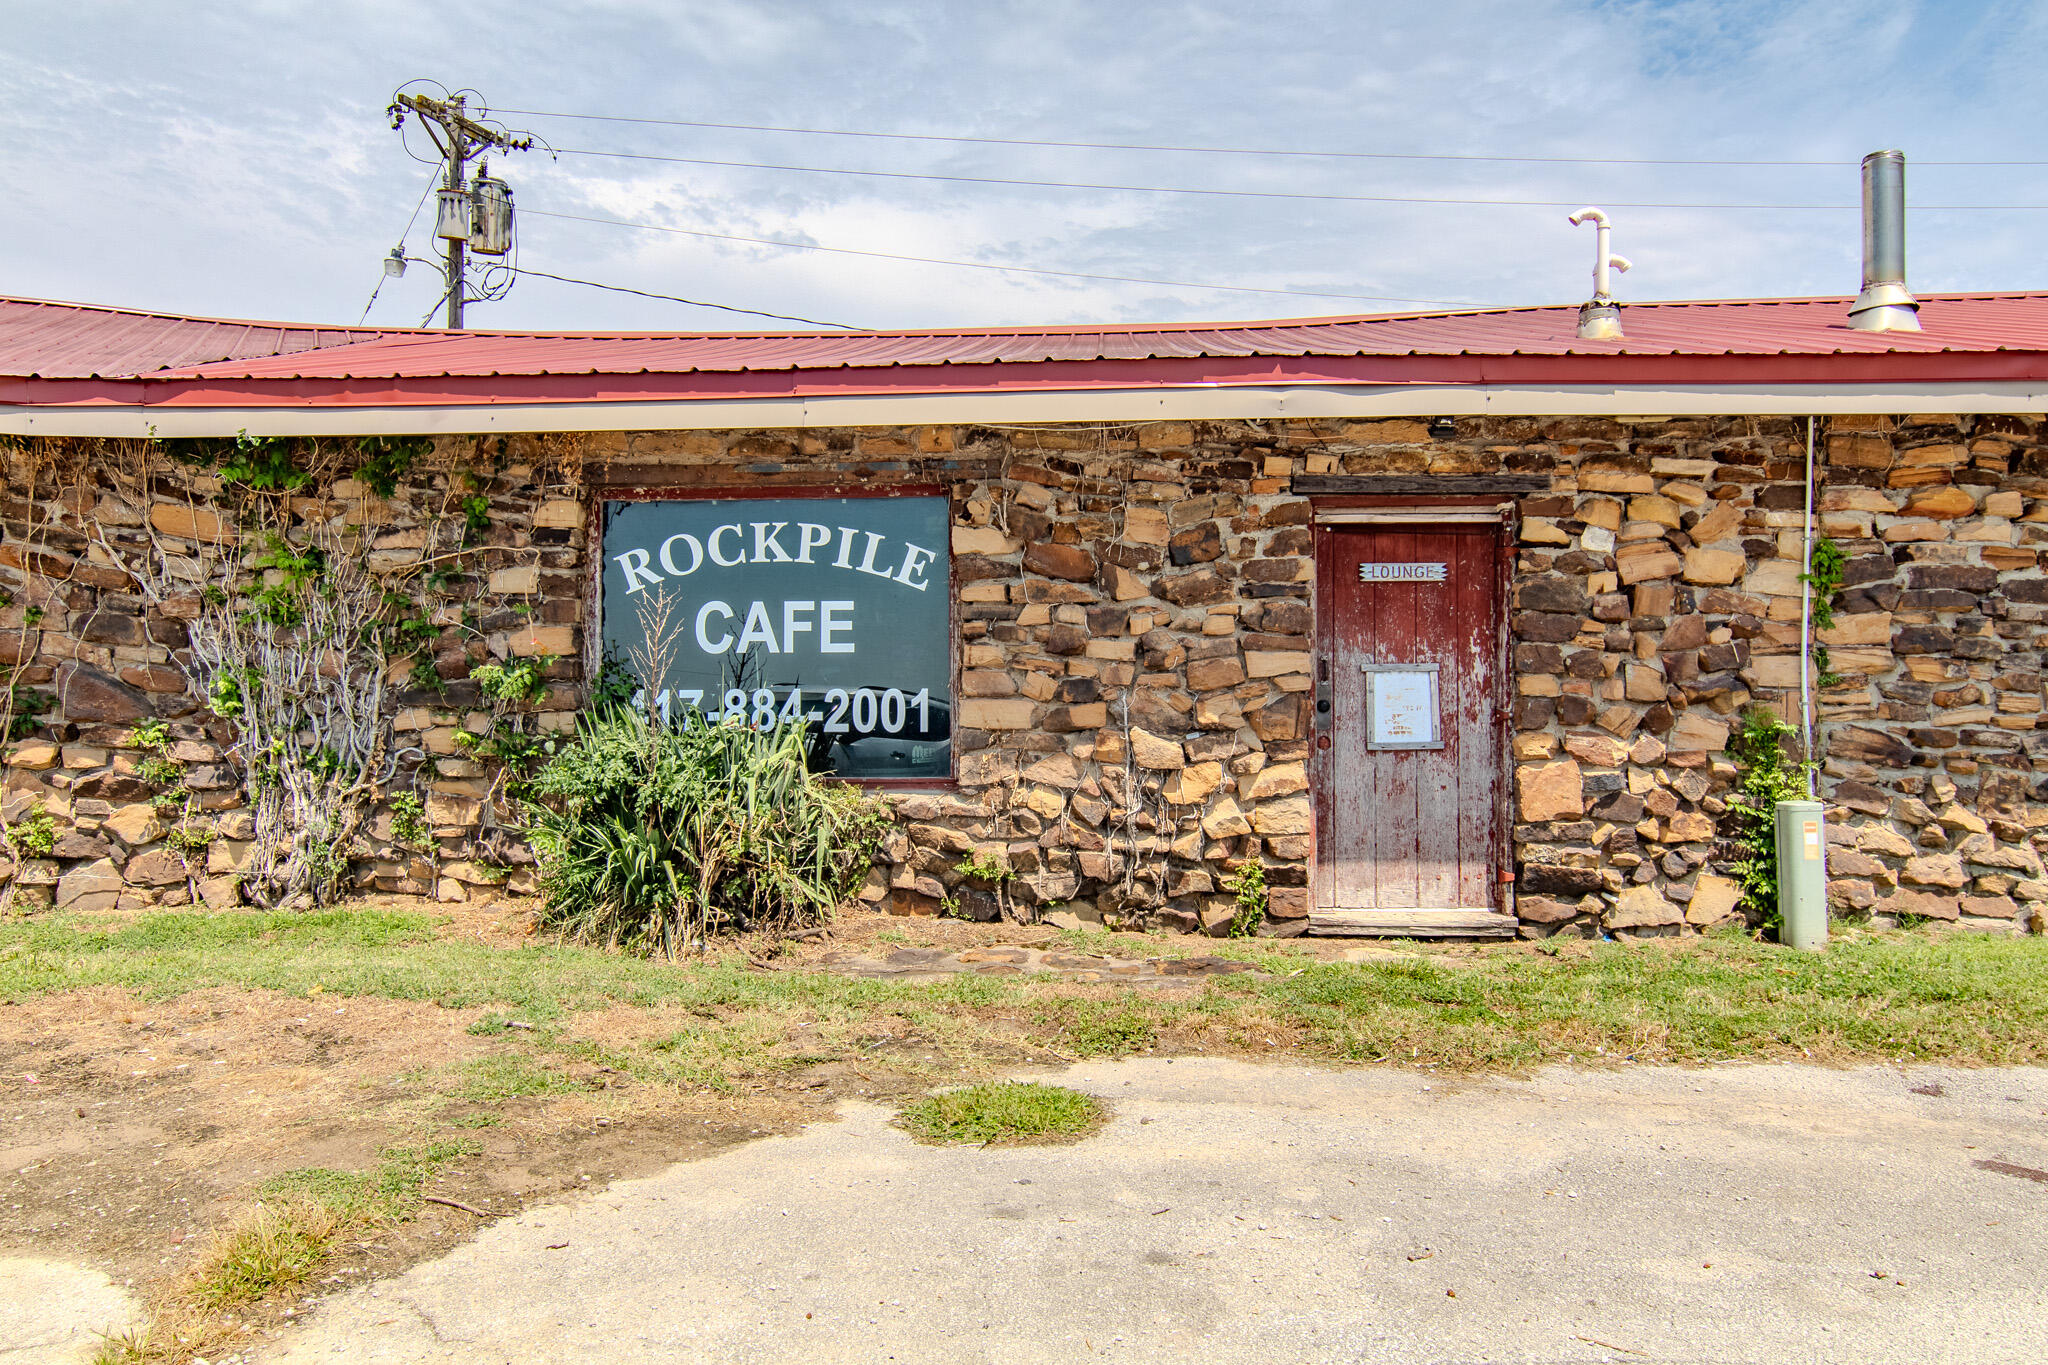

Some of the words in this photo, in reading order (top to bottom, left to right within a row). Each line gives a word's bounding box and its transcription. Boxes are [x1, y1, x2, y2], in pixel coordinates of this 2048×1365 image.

[613, 521, 937, 594] ROCKPILE
[1372, 565, 1434, 579] LOUNGE
[694, 600, 856, 654] CAFE
